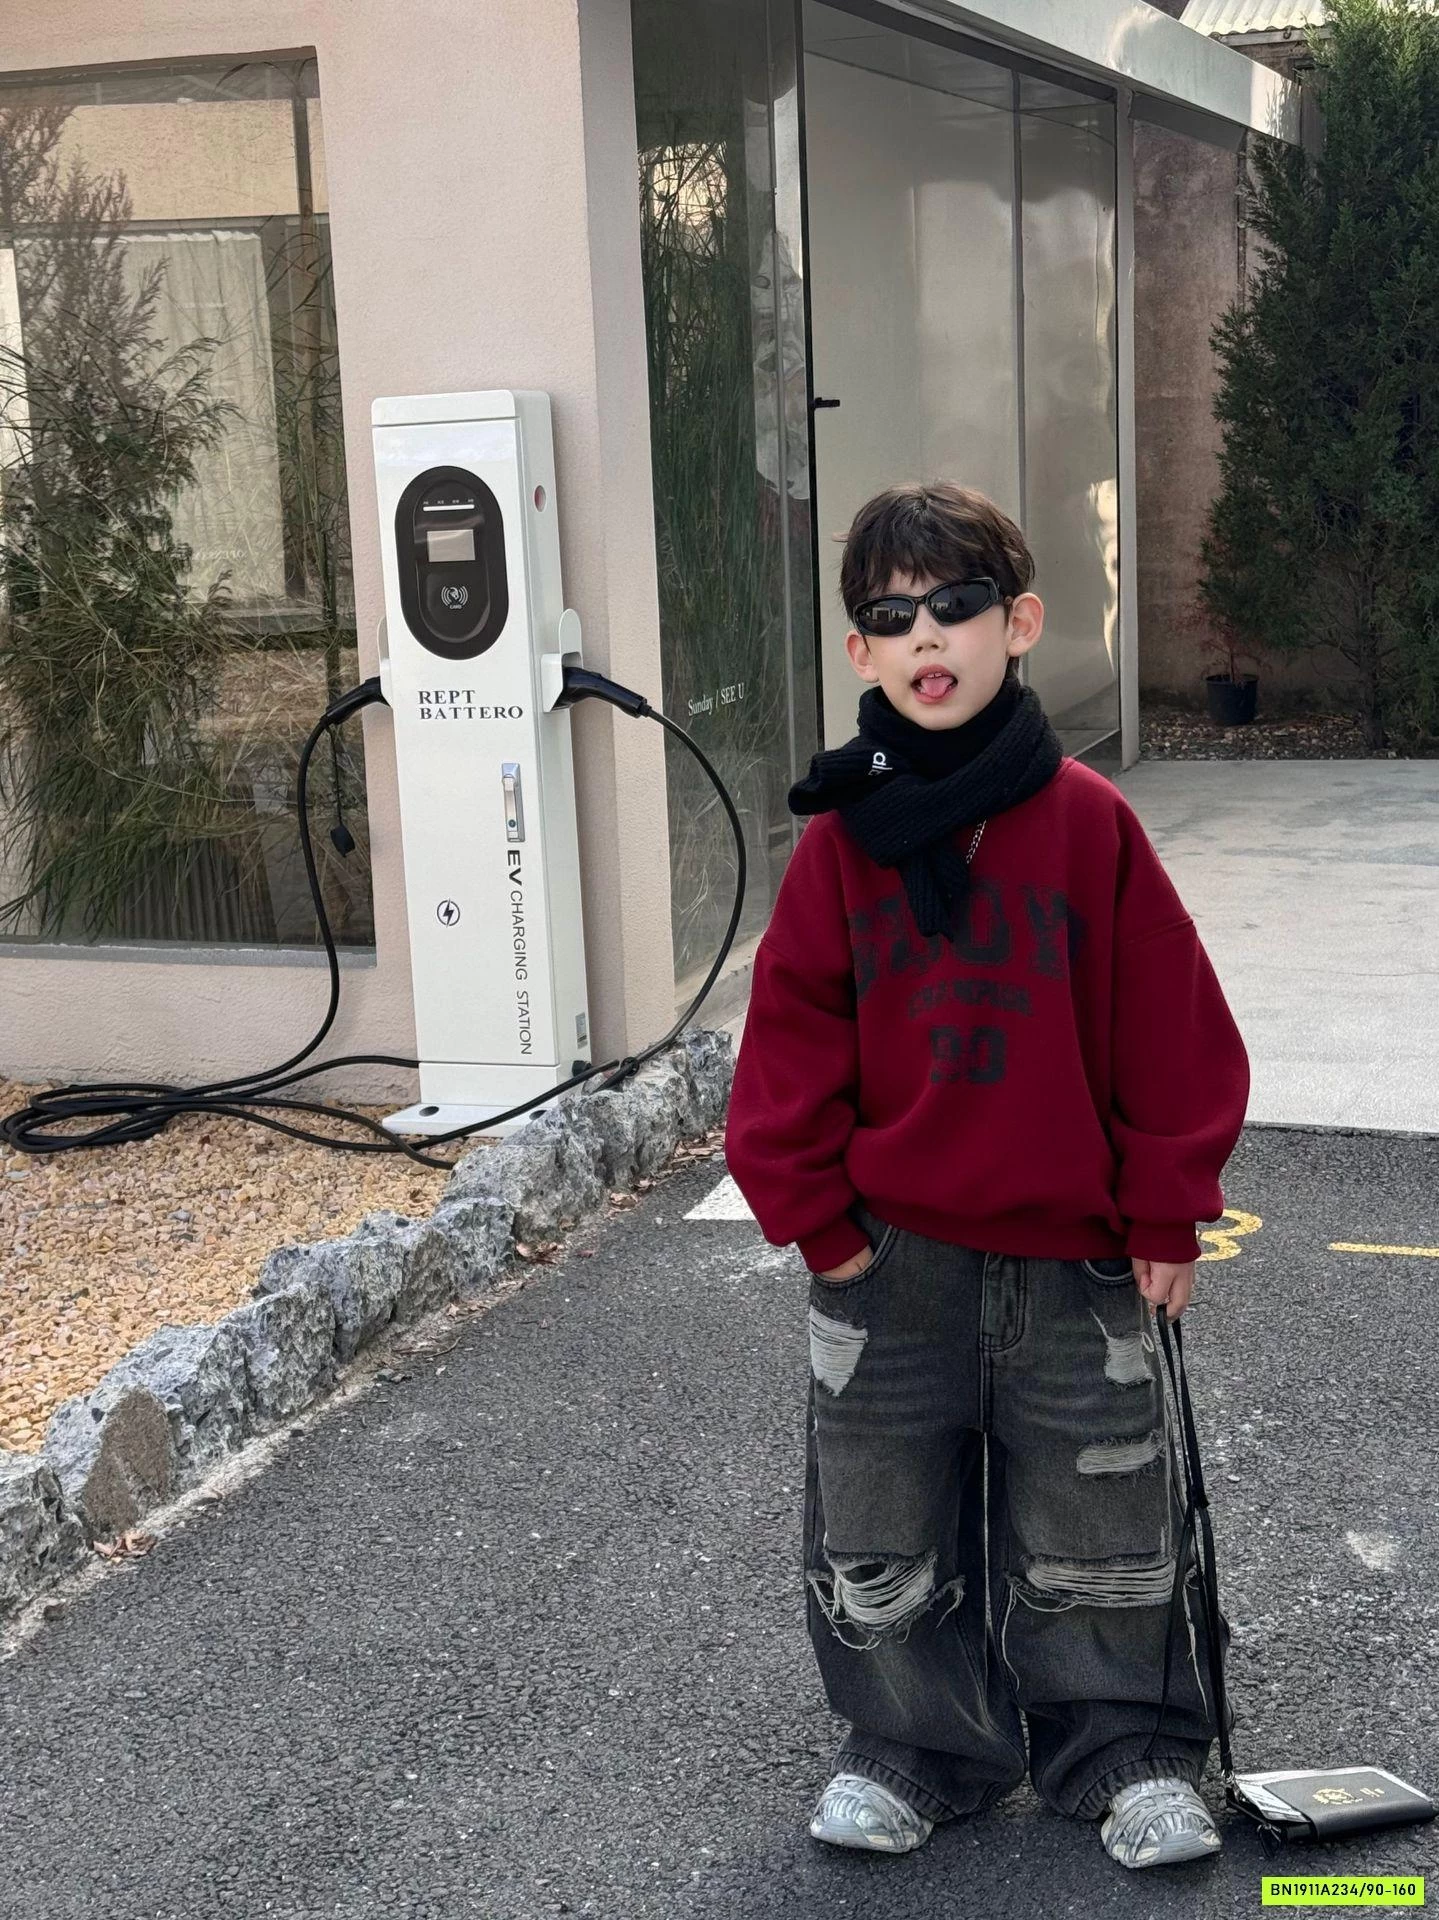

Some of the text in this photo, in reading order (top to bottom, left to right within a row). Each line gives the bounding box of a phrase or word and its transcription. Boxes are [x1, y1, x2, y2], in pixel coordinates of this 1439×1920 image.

[418, 690, 476, 704] REPT
[688, 694, 714, 716] Sunday
[720, 685, 736, 705] SEE
[738, 682, 745, 699] U
[420, 706, 523, 720] BATTERO
[507, 850, 532, 1055] EV CHARGING STATION
